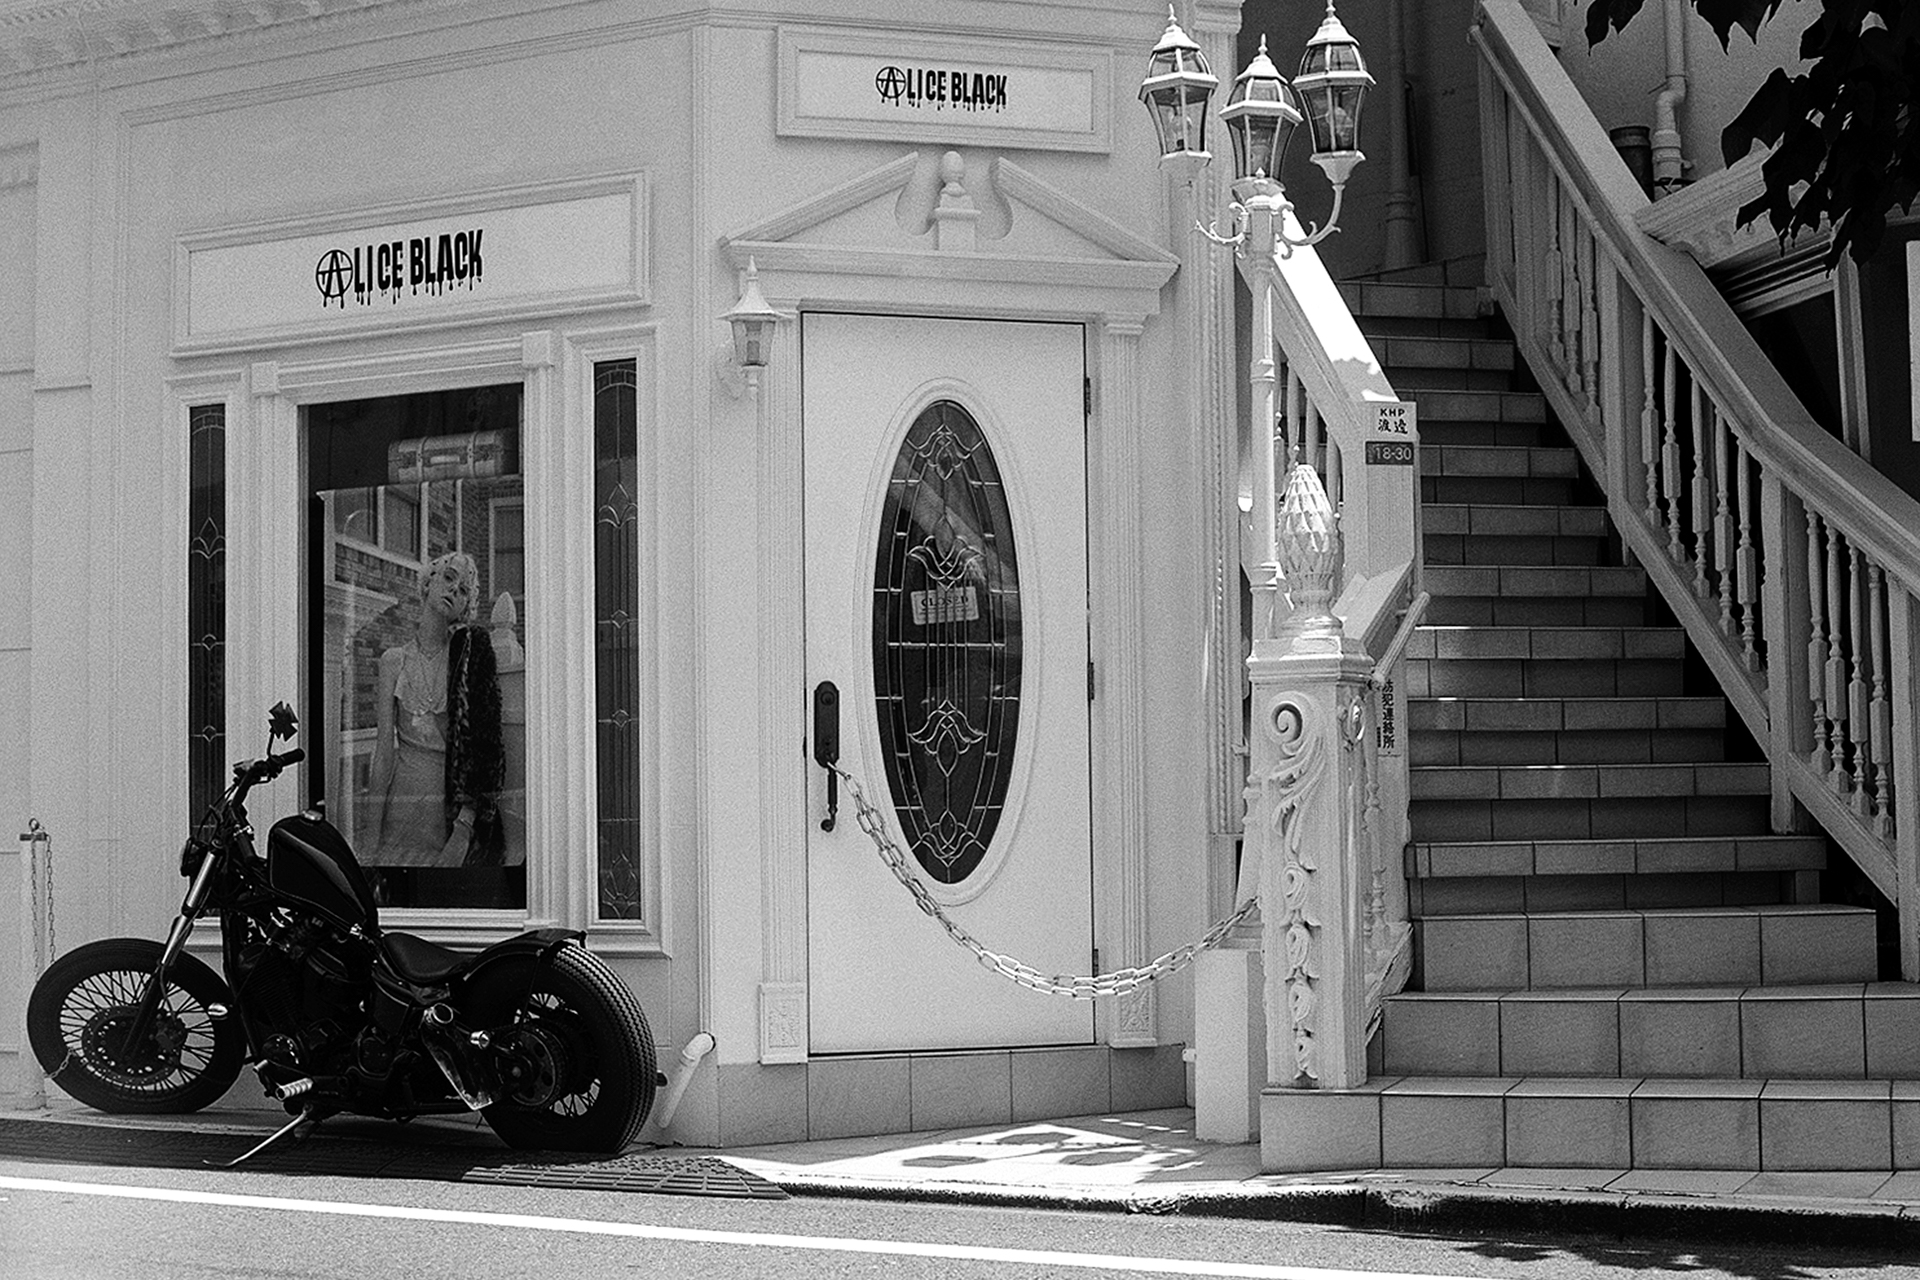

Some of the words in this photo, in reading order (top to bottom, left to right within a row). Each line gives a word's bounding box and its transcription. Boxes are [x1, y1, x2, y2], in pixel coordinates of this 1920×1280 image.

[875, 66, 947, 111] ALICE
[951, 71, 1008, 113] BLACK
[316, 241, 403, 309] ALICE
[410, 229, 483, 296] BLACK
[1380, 408, 1405, 417] KHP
[1375, 447, 1412, 460] 18-30
